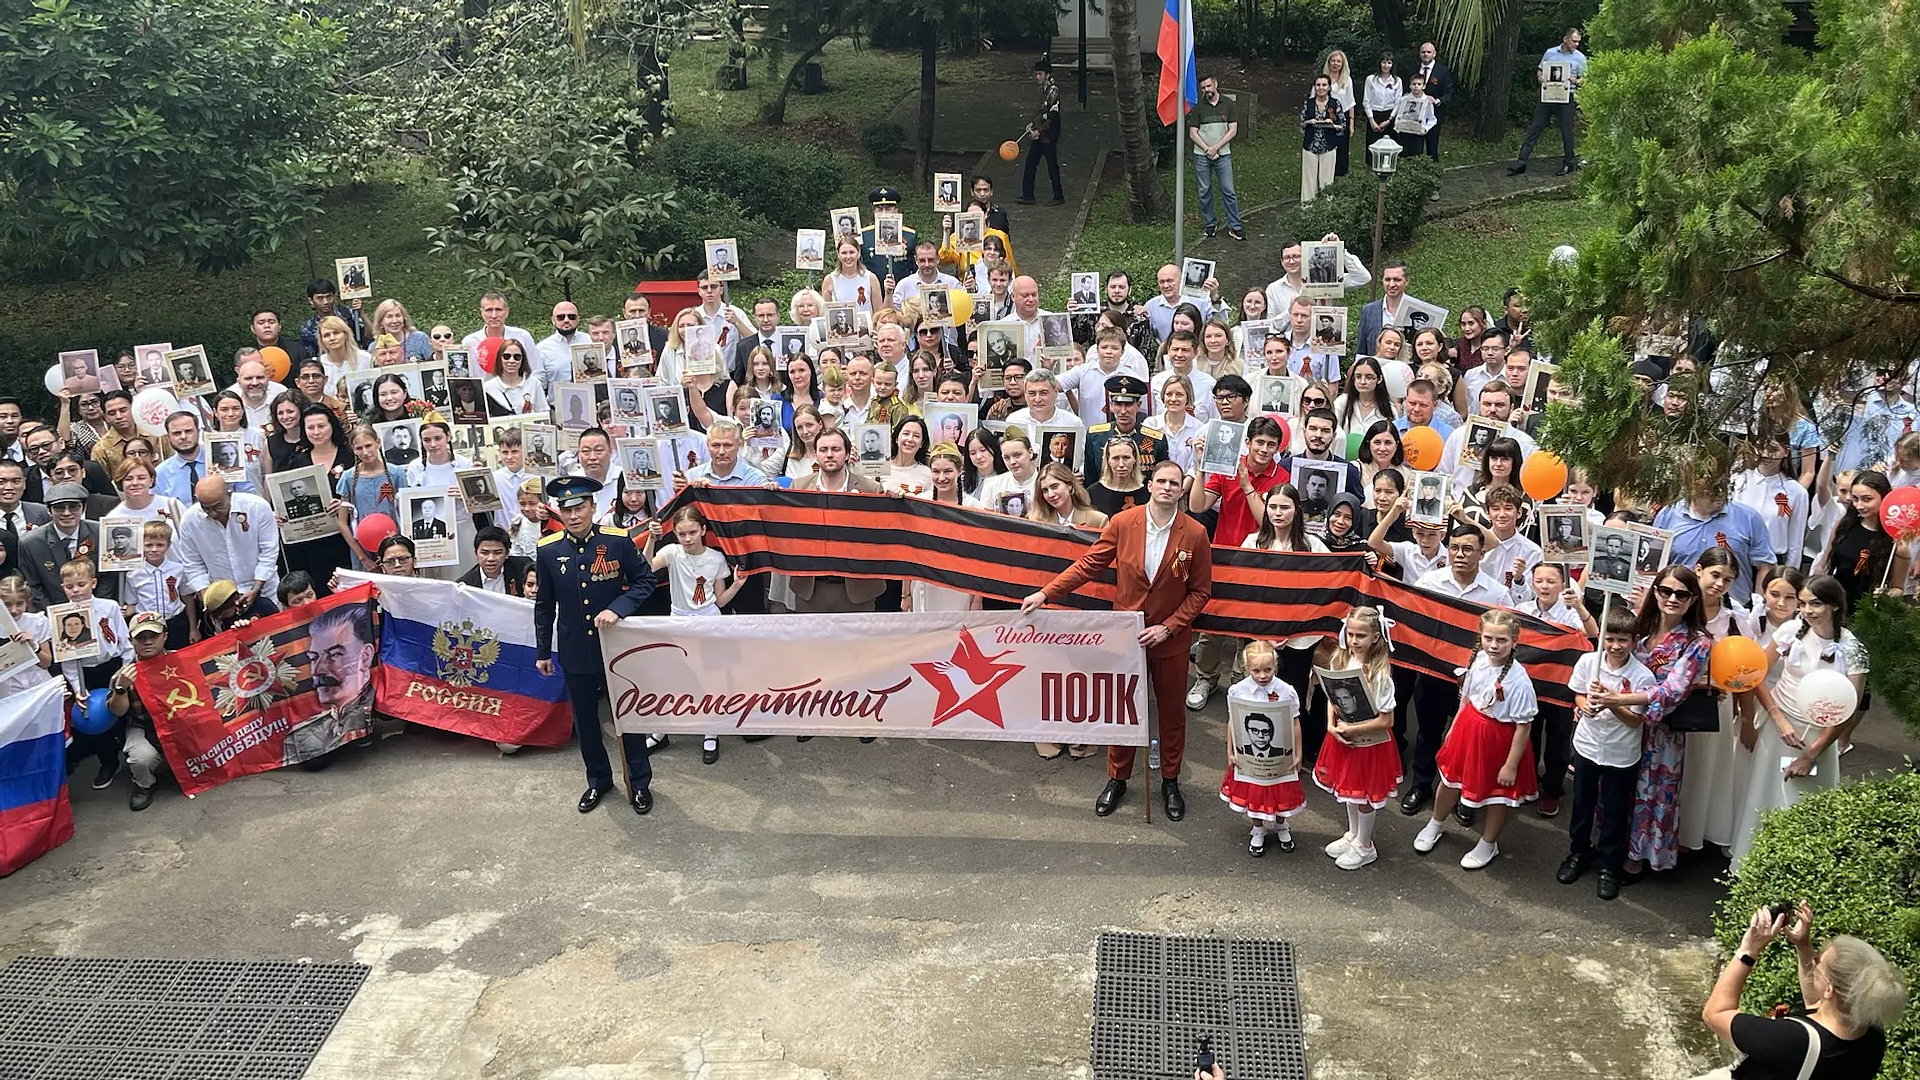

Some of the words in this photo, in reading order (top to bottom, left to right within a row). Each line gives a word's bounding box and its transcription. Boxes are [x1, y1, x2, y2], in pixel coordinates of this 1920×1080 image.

[995, 624, 1105, 646] Индонезия
[405, 681, 504, 716] РОССИЯ
[1040, 672, 1140, 726] ПОЛК
[185, 734, 234, 767] СПАСИБО
[235, 716, 264, 740] ДЕДУ
[189, 762, 212, 777] ЗА
[213, 717, 289, 767] ПОБЕДУ!!!
